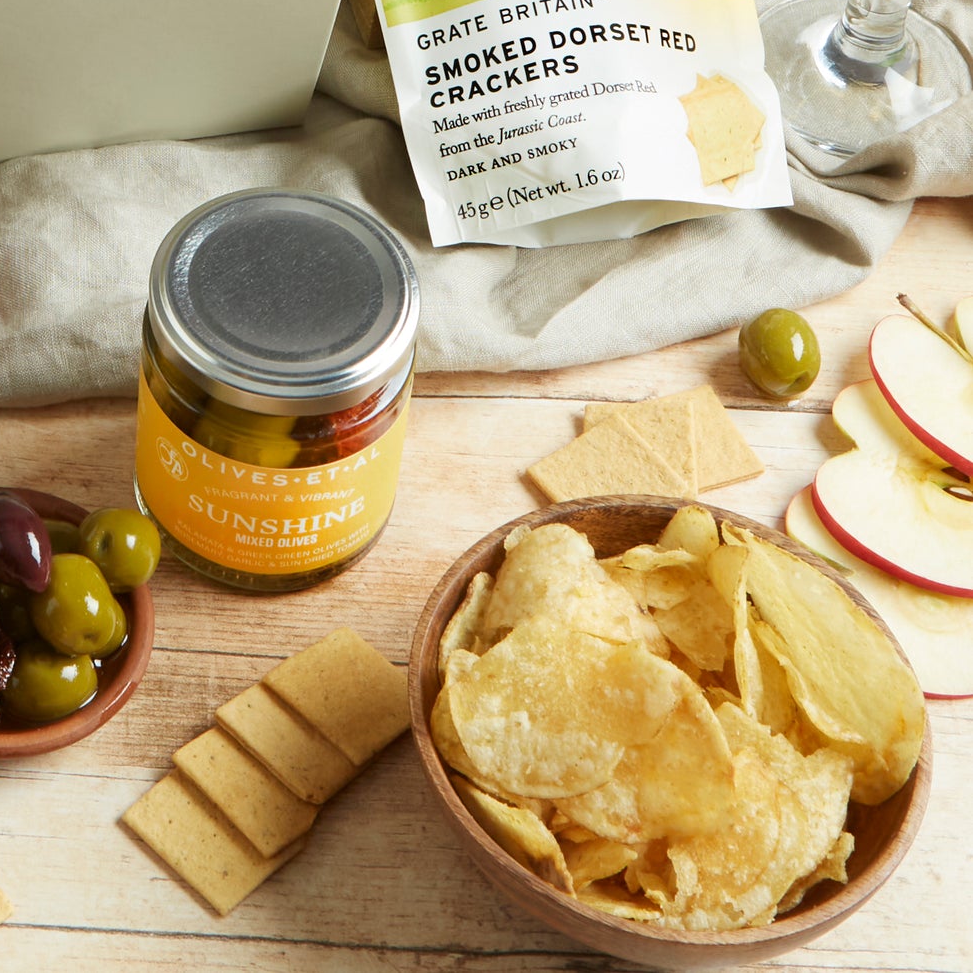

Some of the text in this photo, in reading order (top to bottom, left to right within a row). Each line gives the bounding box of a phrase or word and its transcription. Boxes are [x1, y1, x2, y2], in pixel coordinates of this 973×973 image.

[417, 14, 488, 50] GRATE
[425, 23, 697, 86] SMOKED DORSET RED
[430, 55, 580, 109] CRACKERS
[433, 79, 658, 134] Made with freshly grated Dorset Red
[439, 111, 587, 158] from the Jurassic Coast.
[447, 137, 579, 182] DARK AND SMOKY
[507, 186, 544, 209] (Net
[545, 179, 572, 196] wt.
[576, 168, 599, 189] 1.6
[601, 161, 626, 183] oz)
[188, 493, 366, 536] SUNSHINE
[204, 486, 355, 503] FRAGRANT & VIBRANT
[235, 533, 318, 548] MIXED OLIVES
[279, 559, 302, 568] SUN
[304, 551, 335, 565] DRIED
[313, 538, 346, 555] OLIVES
